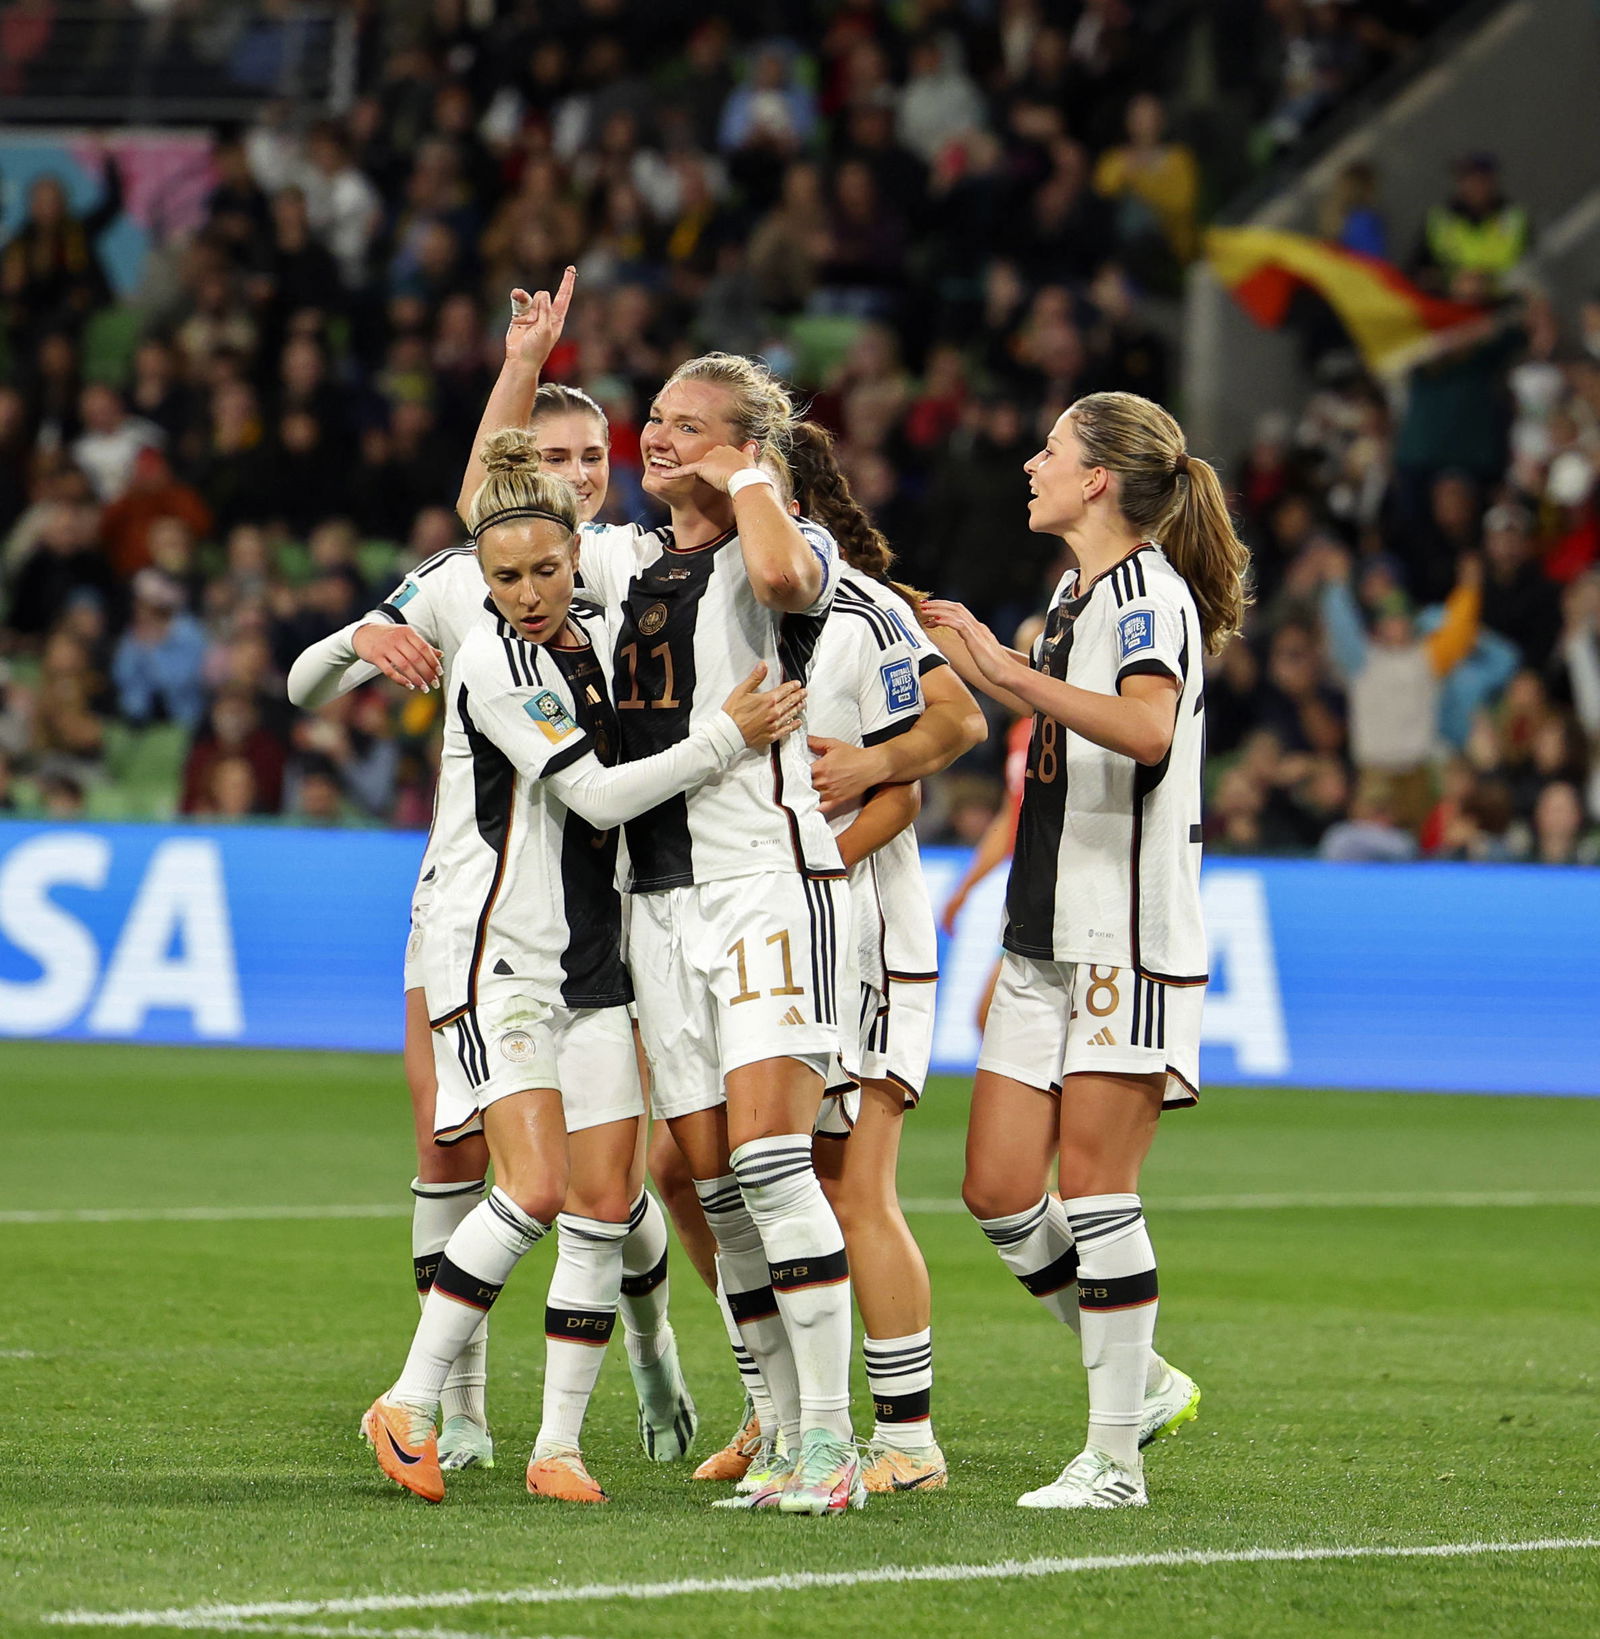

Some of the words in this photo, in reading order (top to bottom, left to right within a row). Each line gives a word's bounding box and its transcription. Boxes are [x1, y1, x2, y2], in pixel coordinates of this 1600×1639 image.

[618, 641, 680, 710] 11
[727, 929, 804, 1008] 11
[415, 1264, 440, 1280] DF
[771, 1266, 809, 1280] DFB
[566, 1317, 609, 1331] DFB
